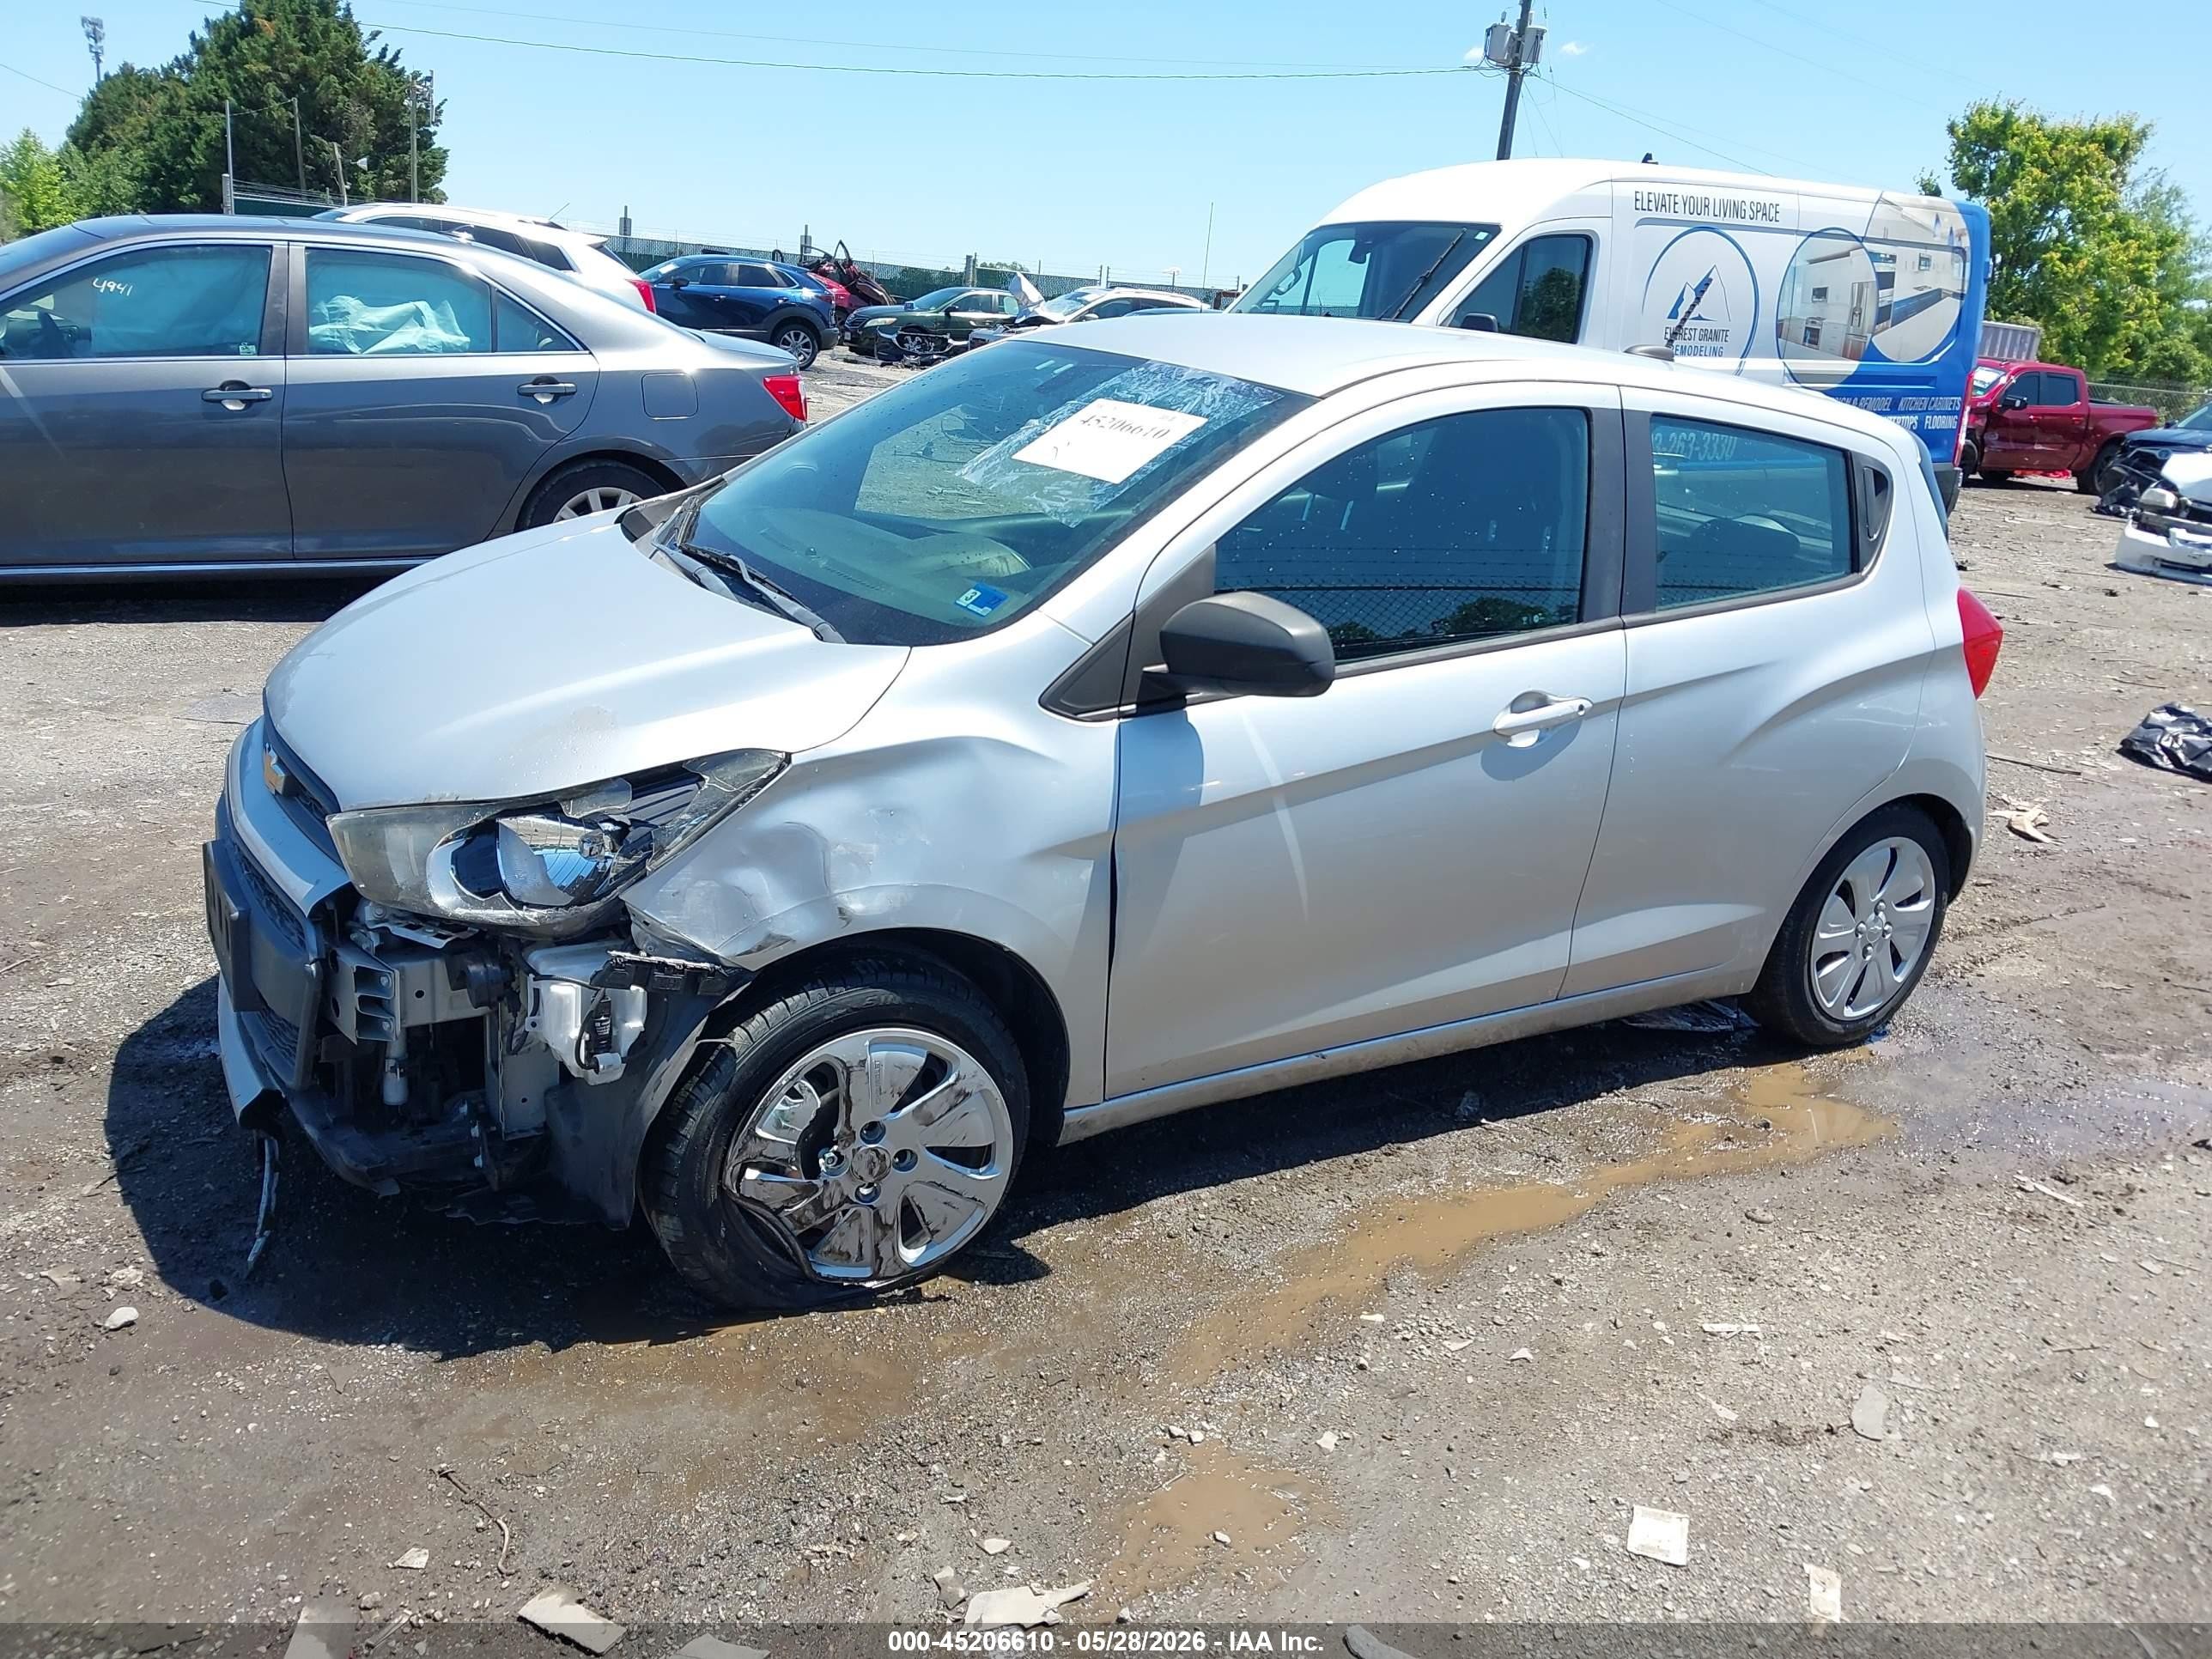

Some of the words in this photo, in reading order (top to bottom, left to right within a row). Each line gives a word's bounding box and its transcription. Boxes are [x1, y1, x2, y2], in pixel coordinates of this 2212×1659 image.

[1634, 191, 1679, 214] ELEVATE
[1681, 195, 1710, 216] YOUR
[1712, 198, 1747, 220] LIVING
[1748, 200, 1780, 222] SPACE
[92, 277, 134, 296] 4941
[1698, 327, 1730, 343] GRANITE
[1670, 343, 1724, 357] EMODELING
[1858, 397, 1893, 411] REMODEL
[1898, 397, 1929, 411] KITCHEN
[1928, 397, 1962, 411] CABINETS
[1923, 415, 1958, 429] FLOORING
